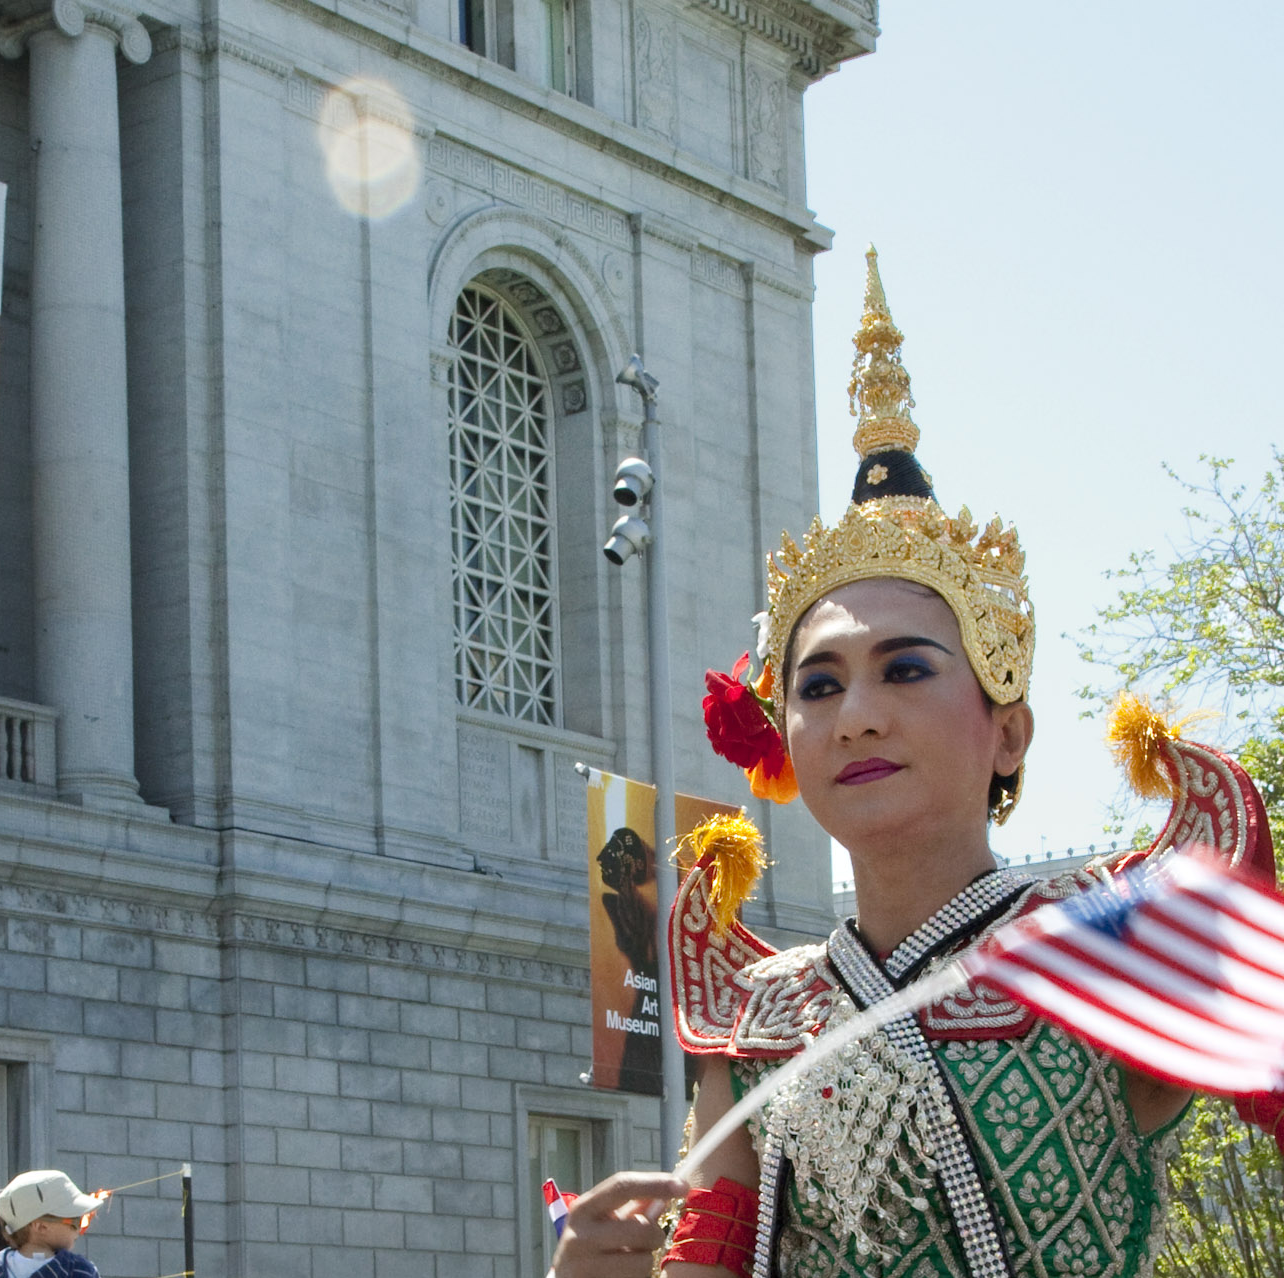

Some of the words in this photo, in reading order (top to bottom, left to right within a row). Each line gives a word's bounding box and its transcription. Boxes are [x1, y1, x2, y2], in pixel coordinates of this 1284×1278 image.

[623, 968, 658, 993] Asian
[641, 995, 659, 1017] Art
[606, 1009, 660, 1038] Museum
